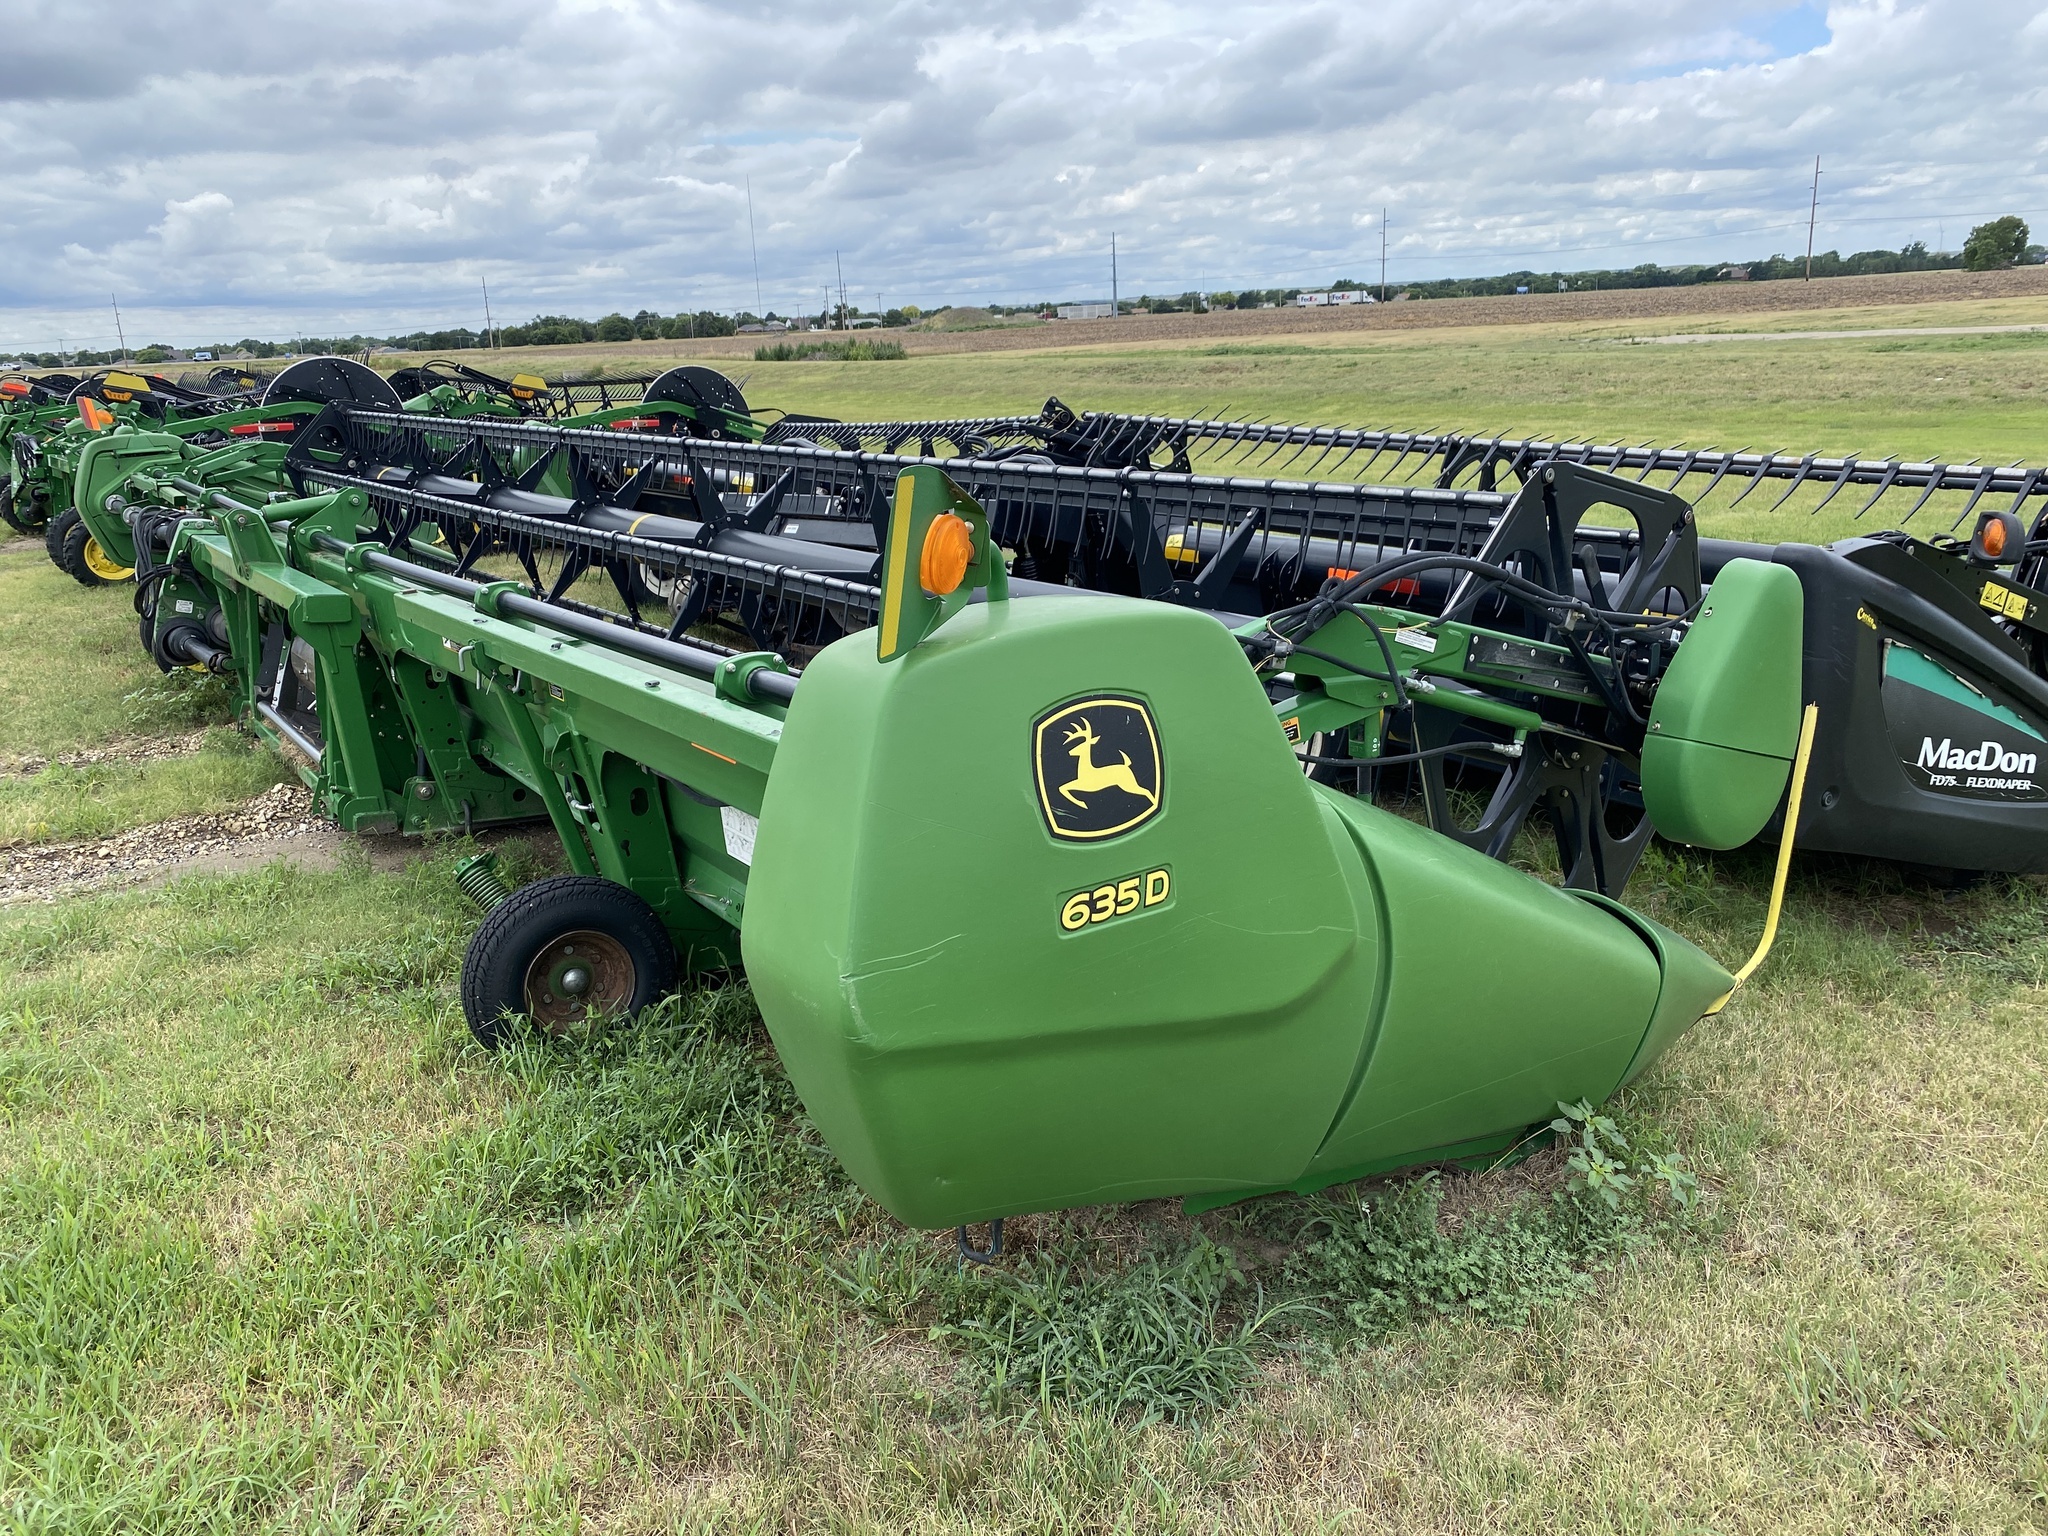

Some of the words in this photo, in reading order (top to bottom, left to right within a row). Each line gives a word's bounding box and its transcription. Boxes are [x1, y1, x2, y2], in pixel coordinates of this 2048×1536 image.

[1917, 736, 2037, 774] MacDon
[1966, 777, 2031, 790] FLEXDRAPER
[1061, 869, 1170, 931] 635D
